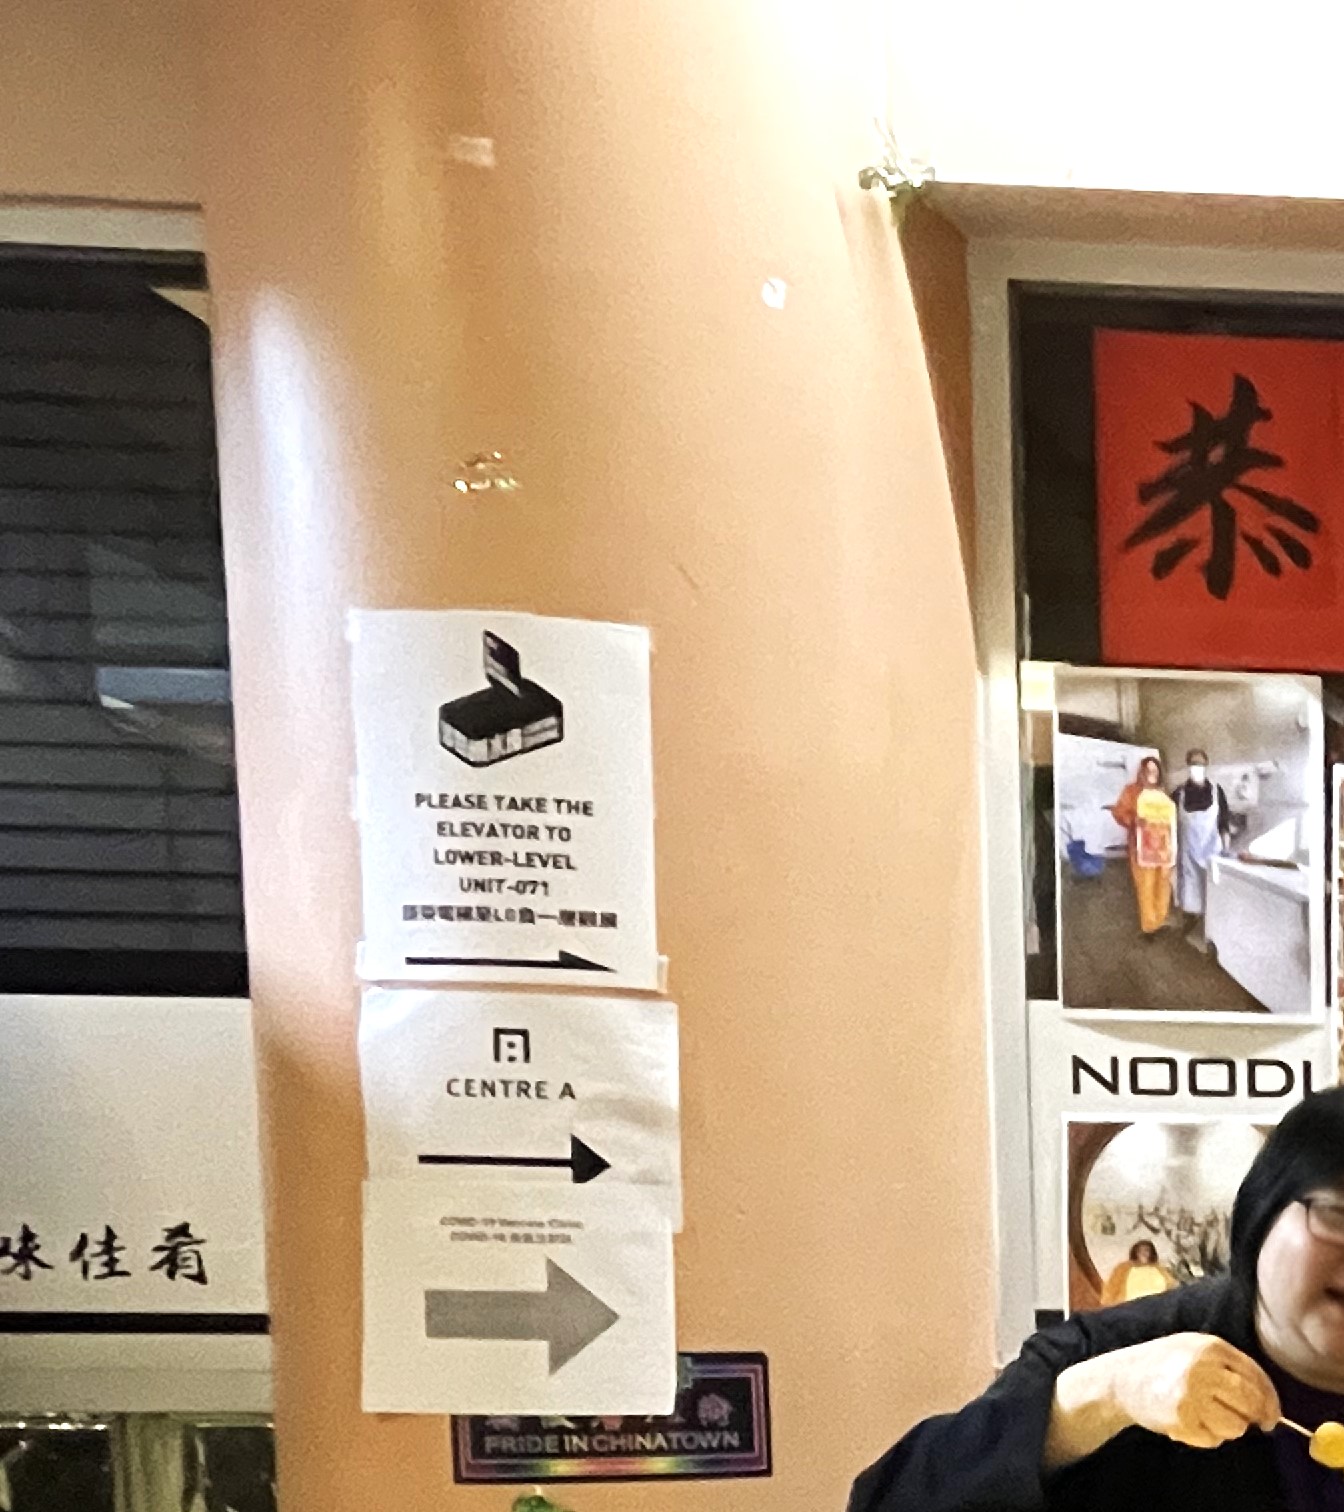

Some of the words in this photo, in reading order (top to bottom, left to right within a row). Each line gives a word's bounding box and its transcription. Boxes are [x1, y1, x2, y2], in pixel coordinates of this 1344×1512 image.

[415, 792, 488, 811] PLEASE
[495, 794, 547, 813] TAKE
[554, 798, 594, 817] THE
[437, 821, 540, 841] ELEVATOR
[546, 824, 572, 842] TO
[433, 849, 577, 871] LOWER-LEVEL
[459, 877, 549, 896] UNIT-071
[447, 1078, 549, 1099] CENTRE
[559, 1082, 576, 1100] A
[484, 1434, 559, 1454] PRIDE
[563, 1432, 589, 1452] IN
[591, 1431, 741, 1452] CHINATOWN
